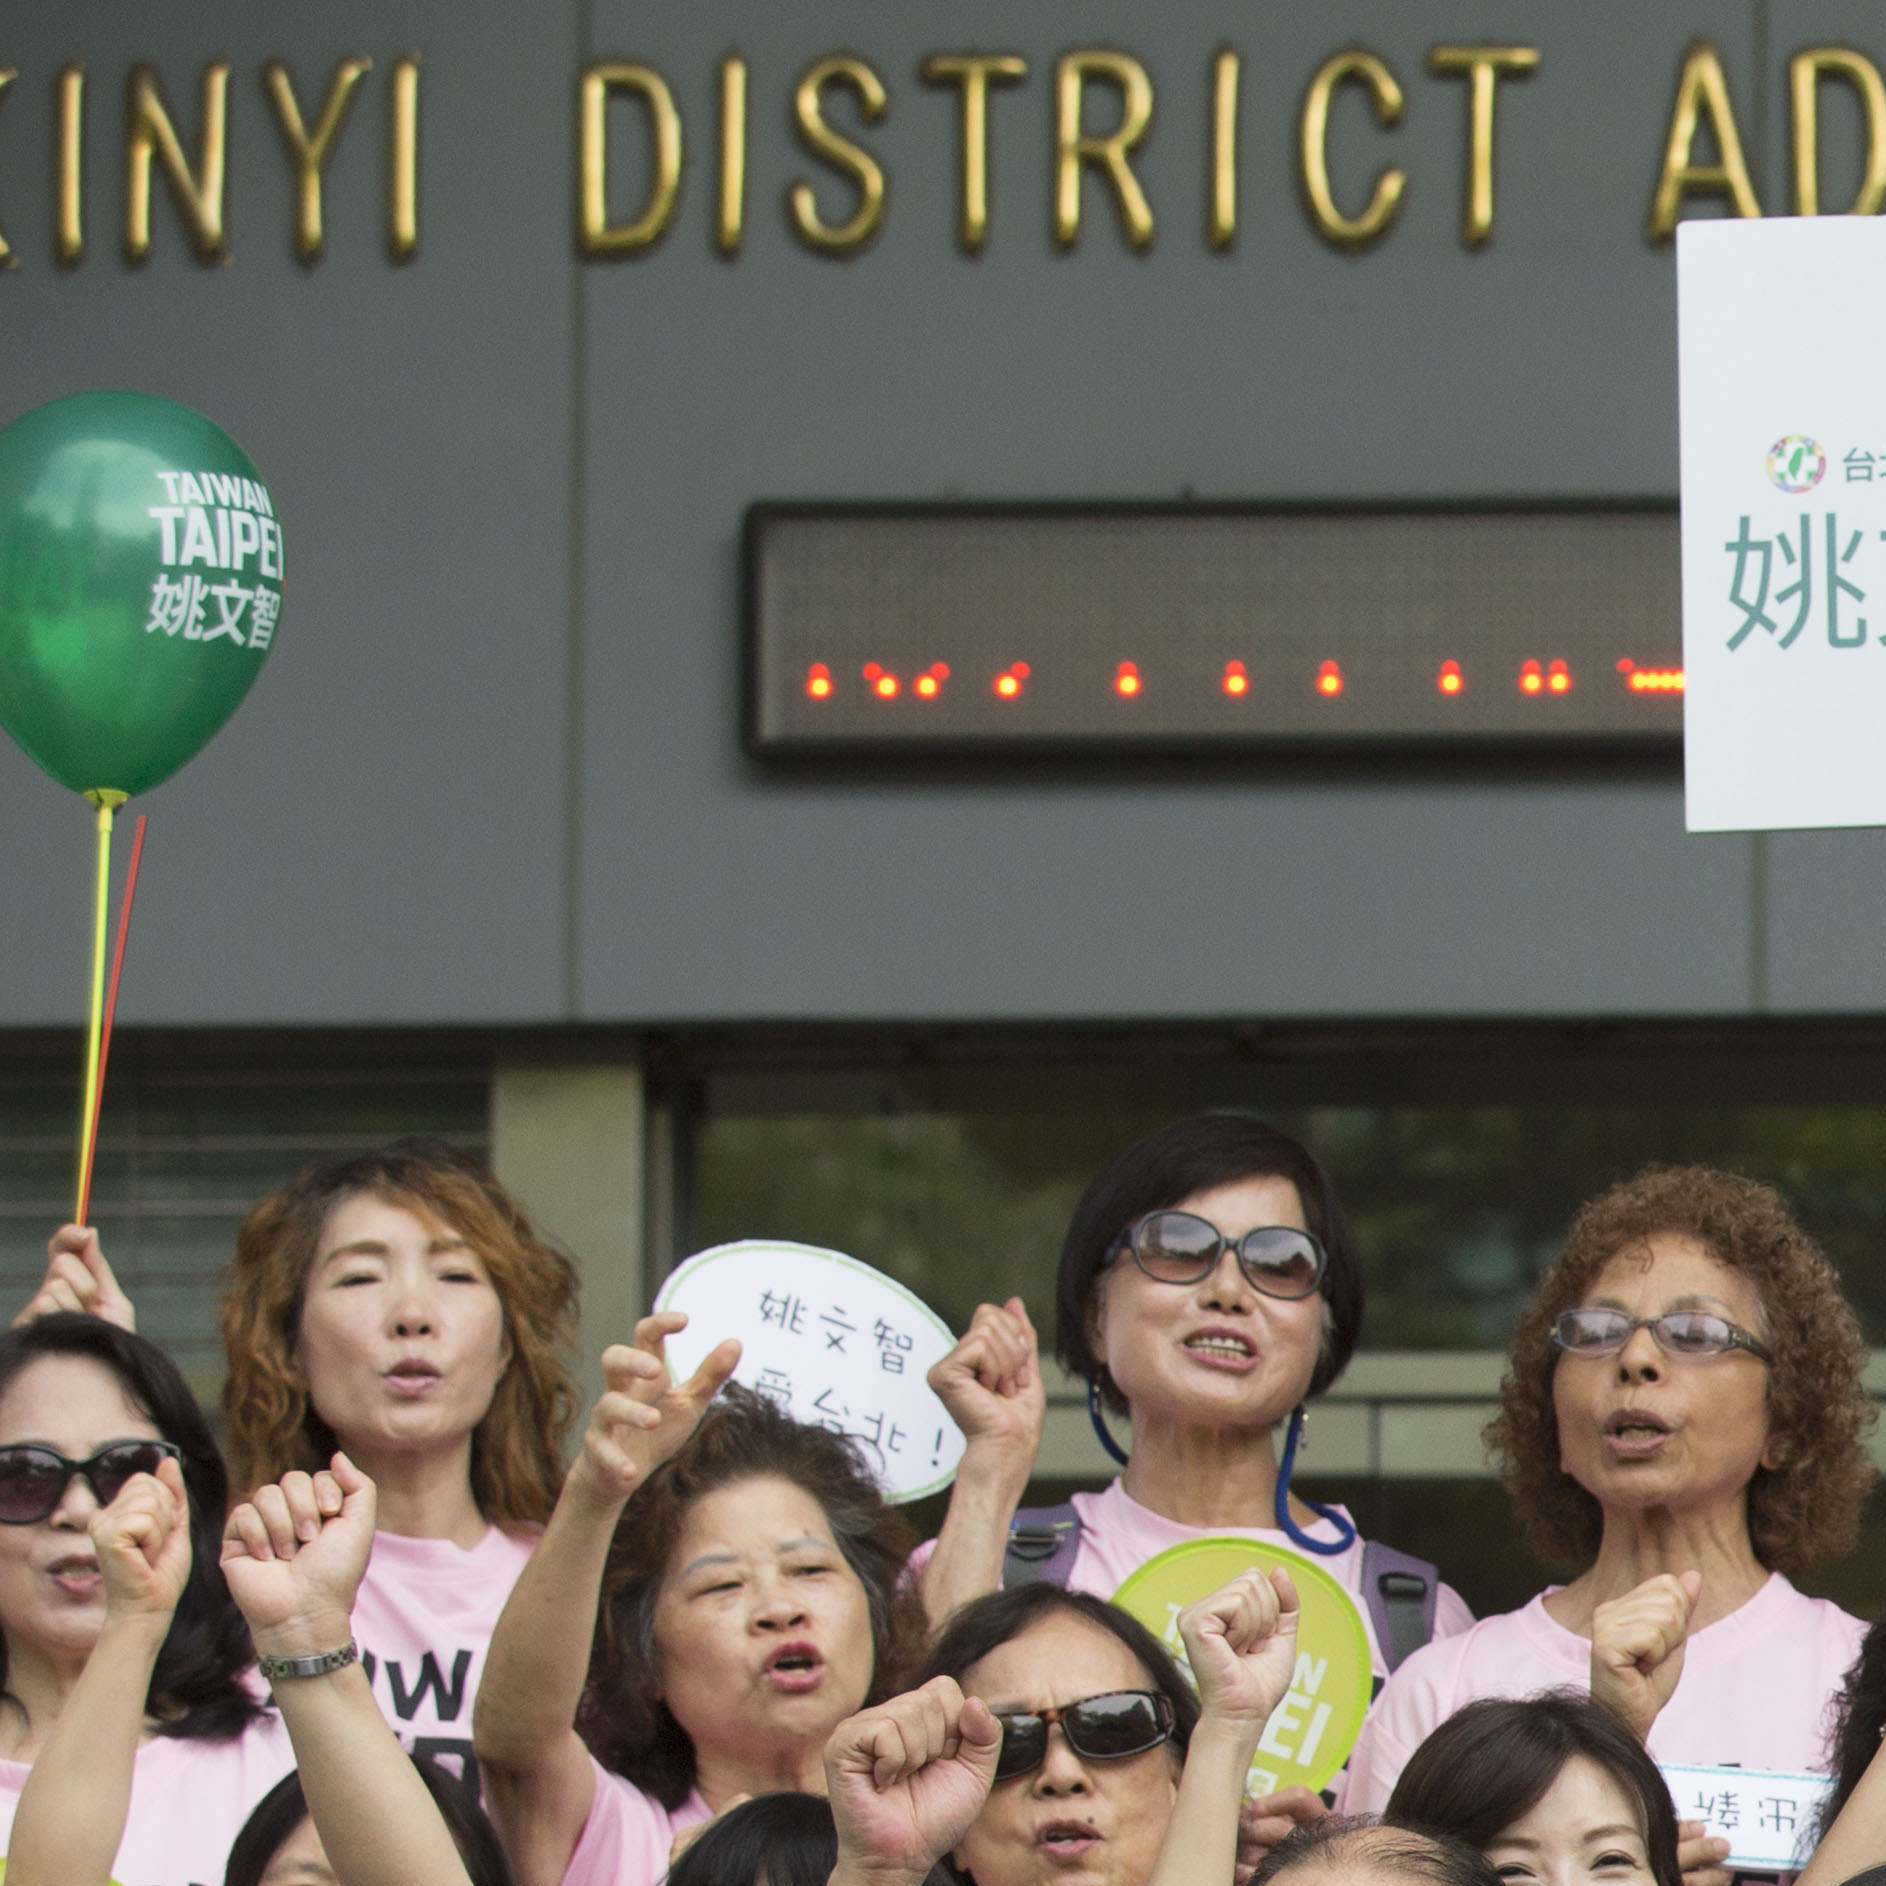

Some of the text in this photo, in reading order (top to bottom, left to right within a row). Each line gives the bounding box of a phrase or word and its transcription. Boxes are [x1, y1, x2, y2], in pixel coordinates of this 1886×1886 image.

[0, 56, 420, 268] INYI
[578, 46, 1541, 258] DISTRICT
[156, 471, 274, 518] TAIWAN
[147, 505, 284, 582] TAIPEI
[145, 573, 281, 650] 姚文智
[759, 1288, 914, 1375] 姚文智
